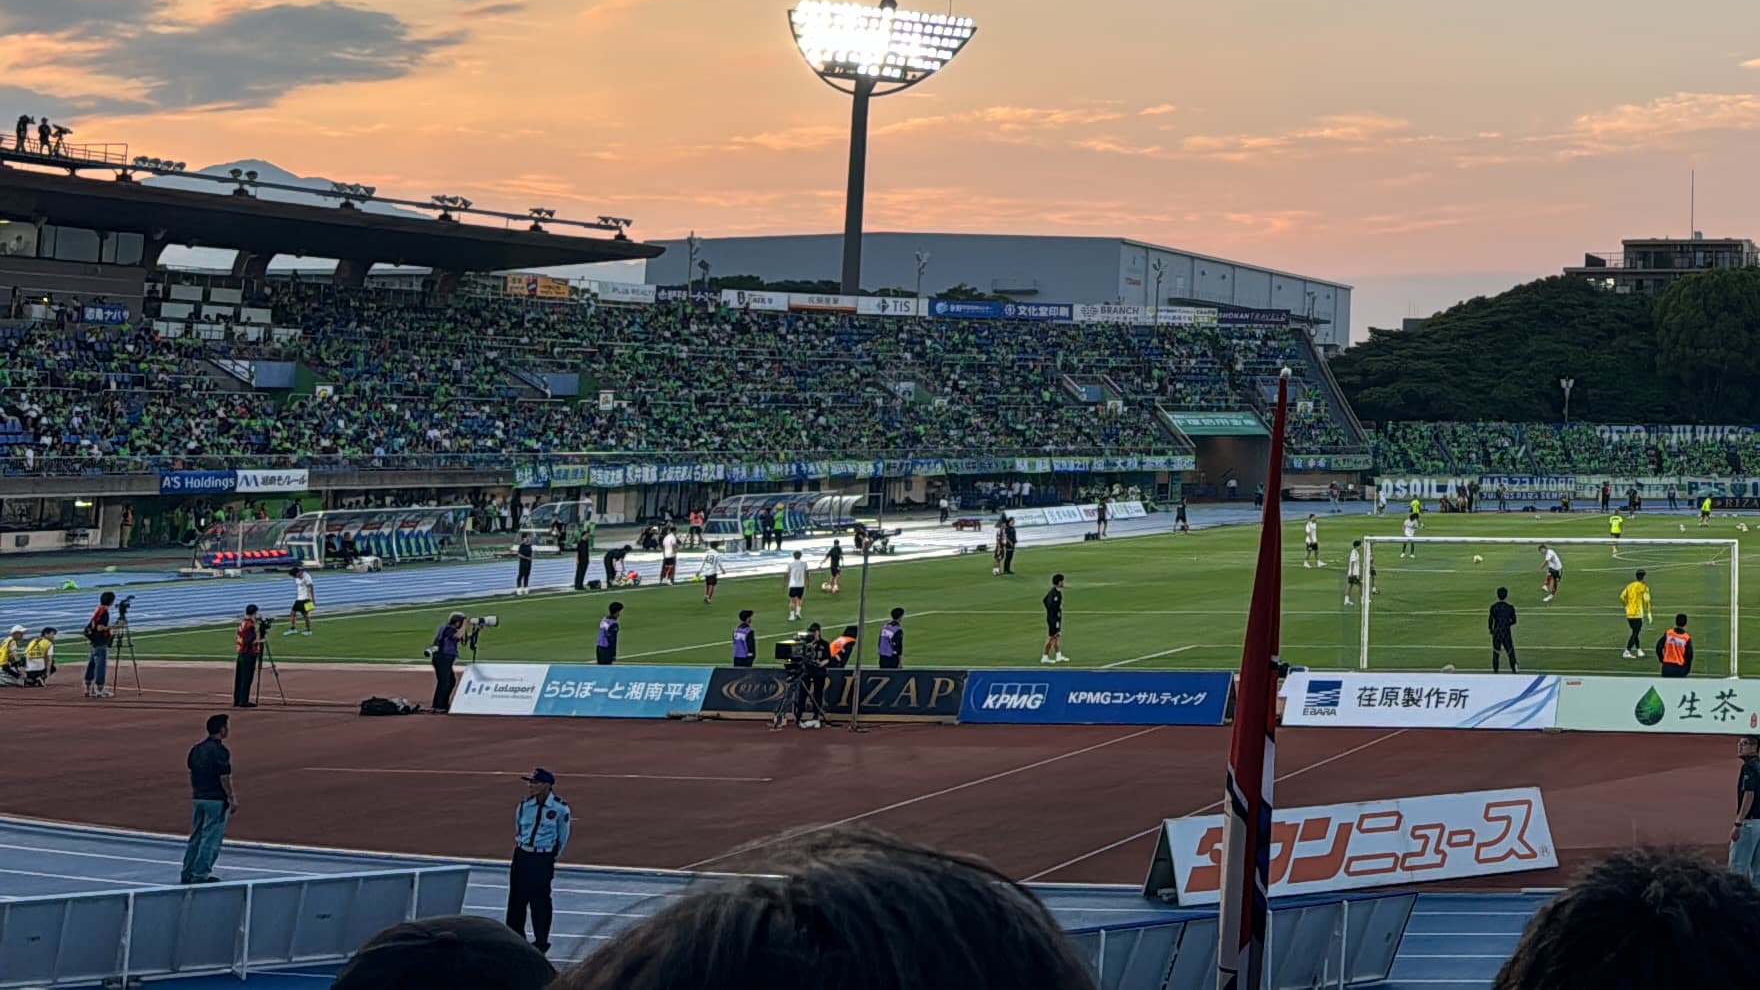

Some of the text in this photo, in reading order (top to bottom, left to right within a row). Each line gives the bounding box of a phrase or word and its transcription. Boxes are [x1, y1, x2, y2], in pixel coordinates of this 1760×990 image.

[184, 475, 235, 491] Holdings
[544, 680, 704, 702] ららぽーと湘南平塚
[982, 692, 1044, 710] KPMG
[1067, 691, 1207, 706] KPMGコンサルティング
[1357, 685, 1470, 709] 荏原製作所
[1677, 688, 1745, 722] 生茶
